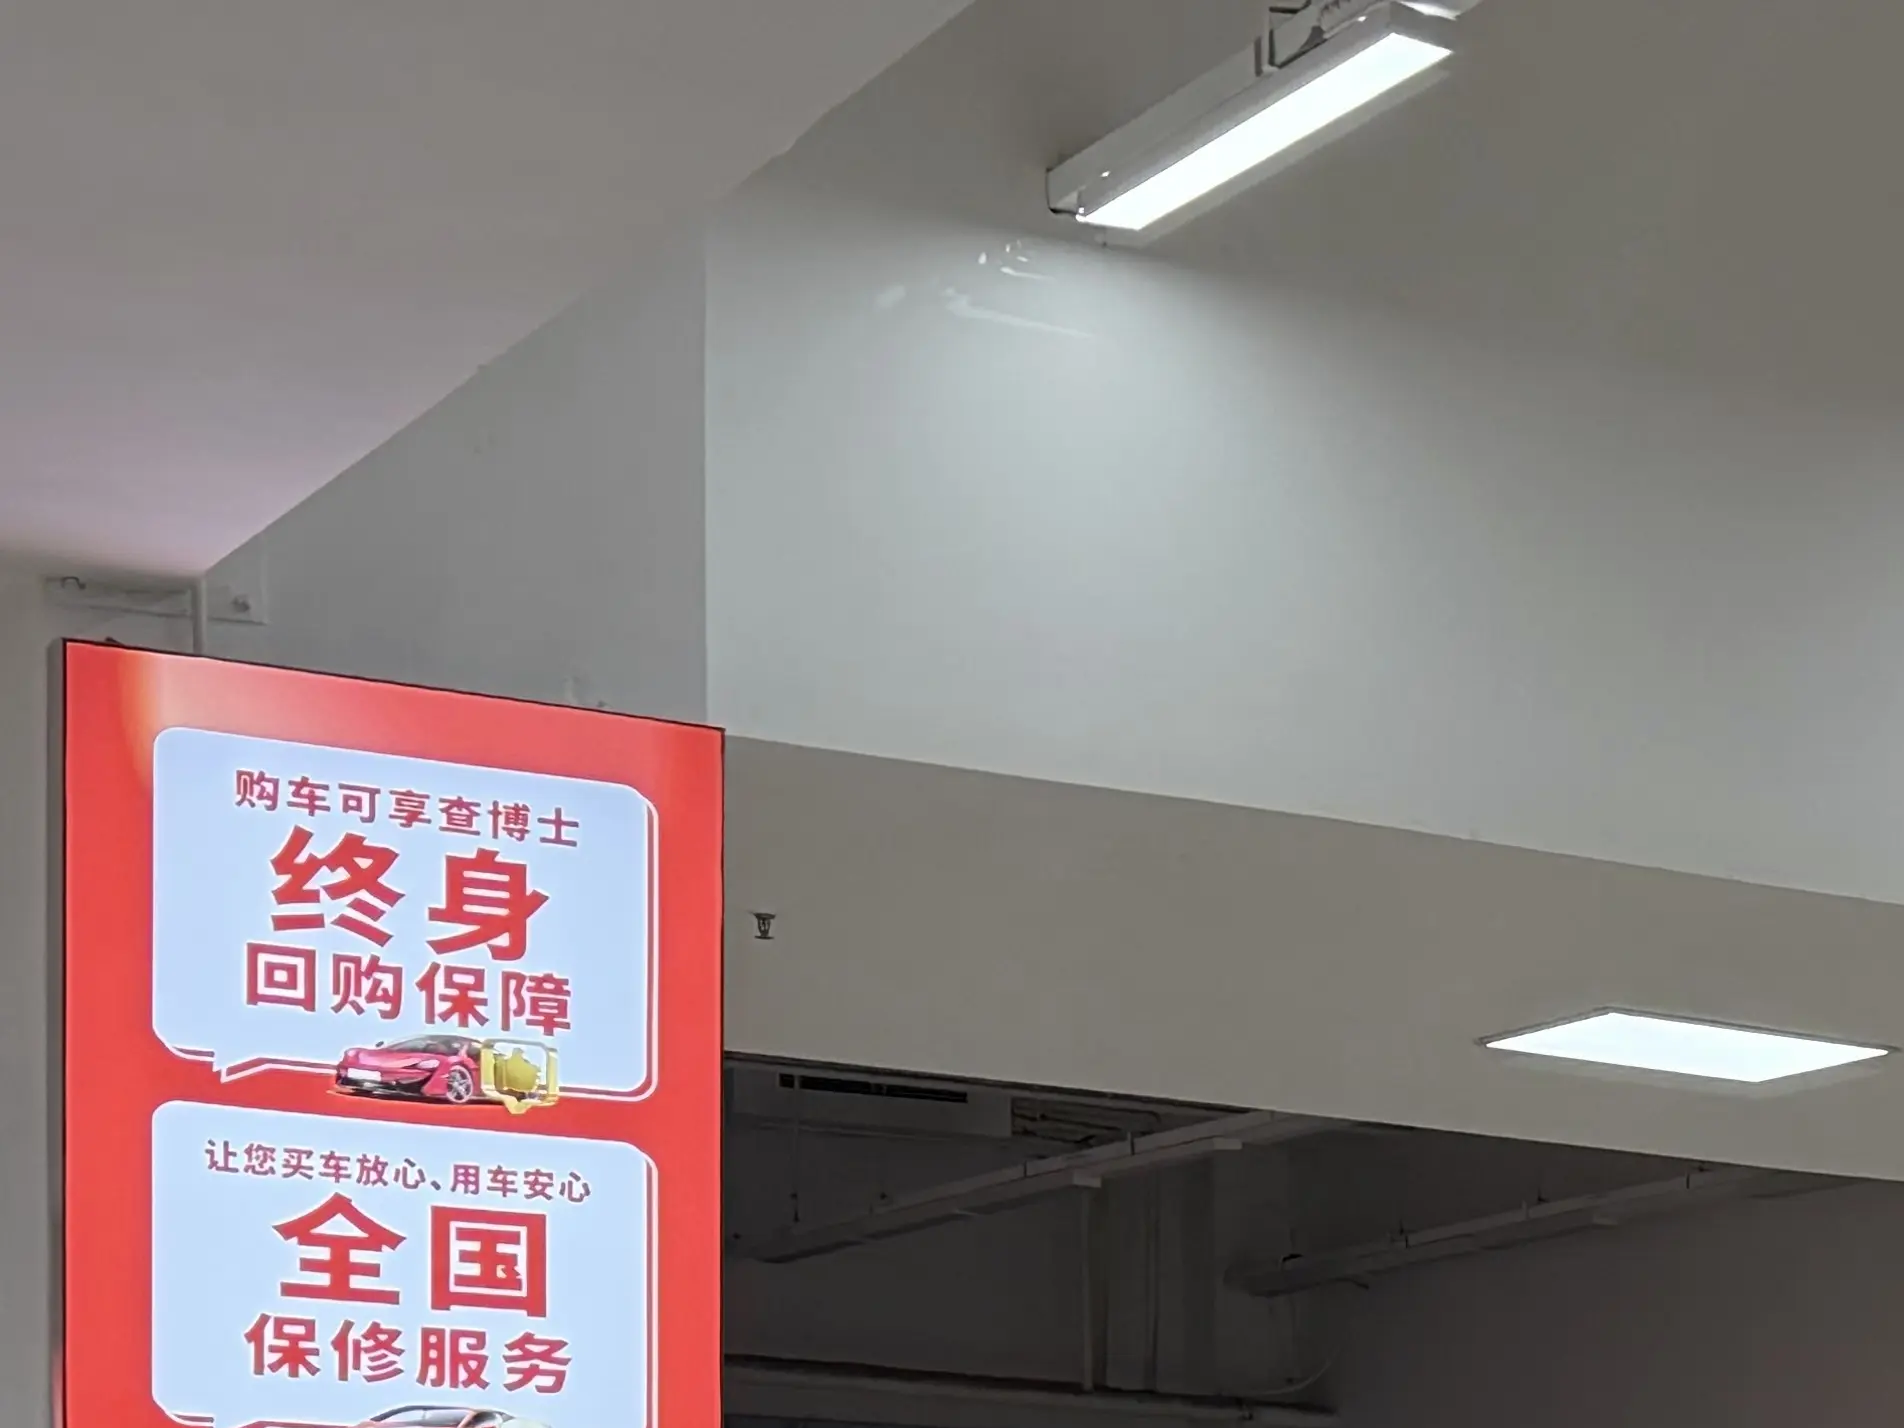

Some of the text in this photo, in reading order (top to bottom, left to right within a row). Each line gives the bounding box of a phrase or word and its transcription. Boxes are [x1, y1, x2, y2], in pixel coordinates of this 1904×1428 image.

[235, 769, 579, 847] 购车可享查博士
[270, 825, 550, 961] 终身
[244, 942, 572, 1036] 回购保障
[204, 1139, 591, 1203] 让您买车放心、用车安心
[272, 1191, 548, 1318] 全国
[243, 1312, 573, 1394] 保修服务
